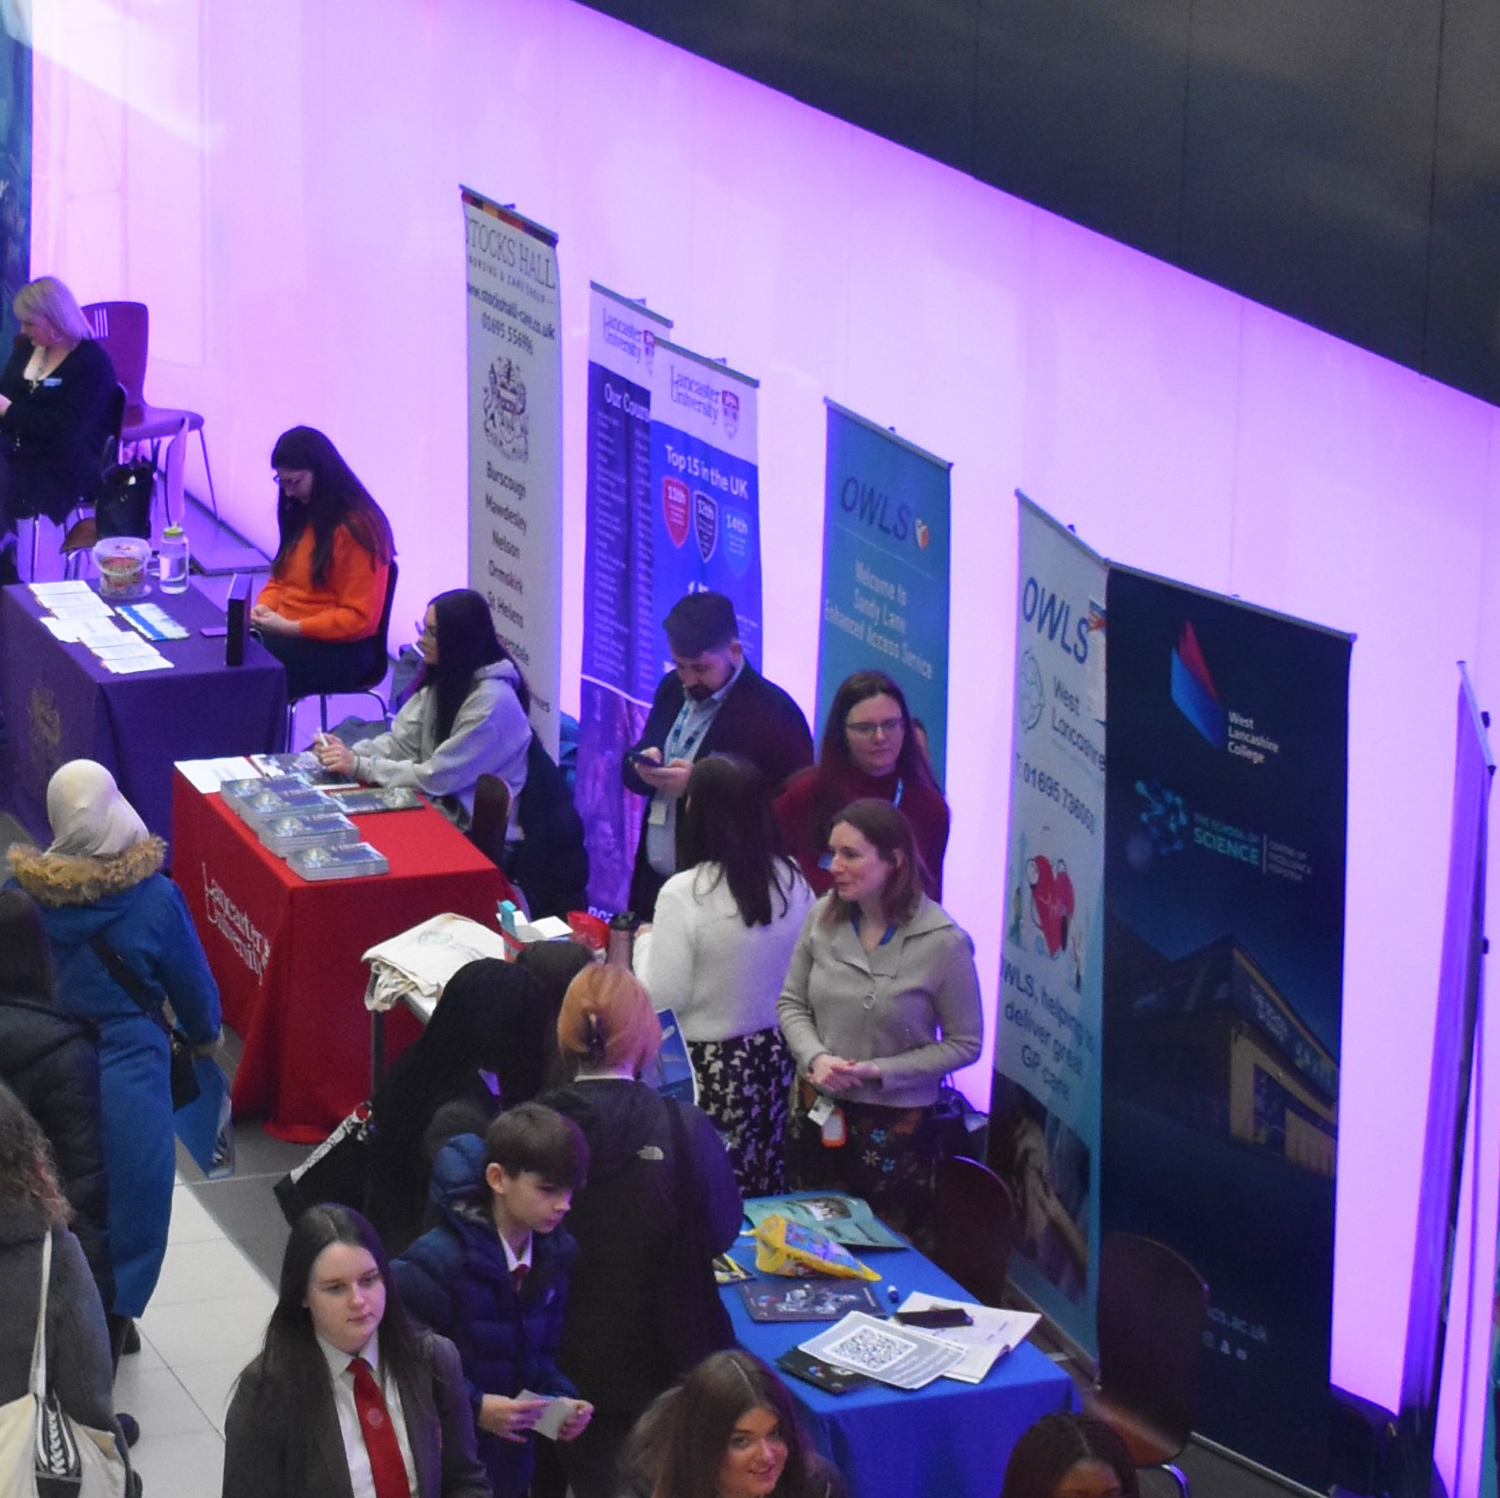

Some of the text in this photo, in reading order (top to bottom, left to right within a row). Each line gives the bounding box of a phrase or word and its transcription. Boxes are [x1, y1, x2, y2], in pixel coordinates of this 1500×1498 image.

[519, 242, 556, 289] HALL
[603, 307, 642, 342] Lancaster
[604, 383, 622, 408] Our
[671, 365, 720, 400] Lancaster
[671, 392, 718, 425] University
[486, 461, 526, 500] Burscough
[665, 445, 747, 499] Top 15 in the UK
[485, 493, 527, 535] Mawdesley
[841, 476, 911, 541] OWLS
[491, 529, 520, 560] Nelson
[488, 559, 523, 597] Ormskirk
[497, 596, 525, 629] Helens
[1023, 577, 1088, 664] OWLS
[1054, 676, 1080, 717] West
[1228, 711, 1254, 729] West
[1228, 726, 1279, 753] Lancashire
[1228, 741, 1265, 764] College
[1194, 827, 1260, 866] SCIENCE
[202, 862, 263, 955] Lancaster
[206, 899, 262, 985] University
[1005, 1003, 1051, 1046] deliver
